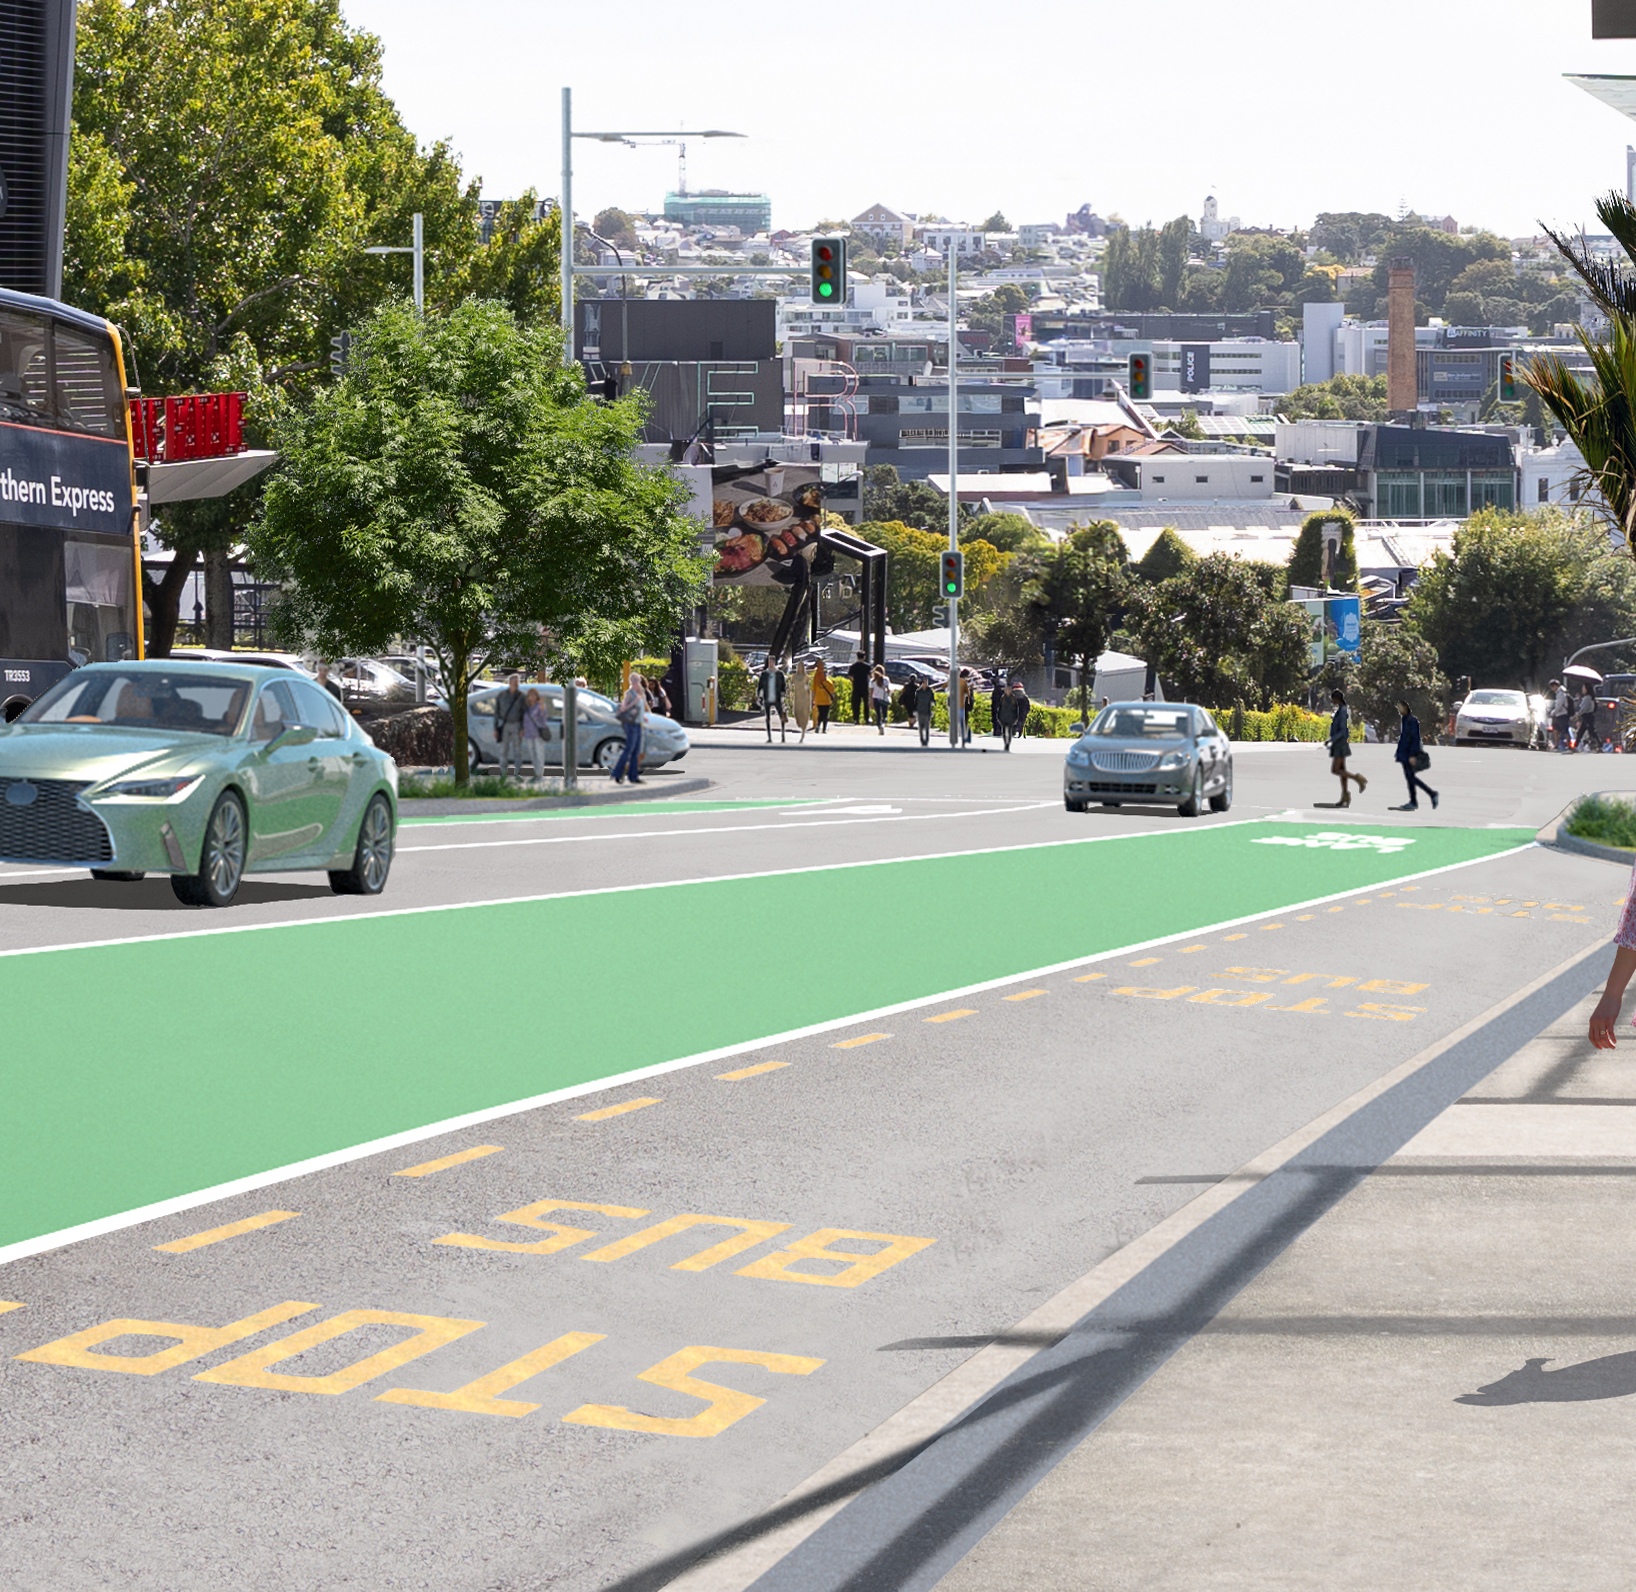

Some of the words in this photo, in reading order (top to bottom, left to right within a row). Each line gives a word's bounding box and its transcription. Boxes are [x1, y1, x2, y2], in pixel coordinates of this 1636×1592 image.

[1186, 351, 1195, 382] POLICE
[50, 475, 115, 517] Express
[4, 669, 31, 683] TR3553
[1208, 966, 1431, 995] BUS
[1107, 985, 1427, 1021] STOP
[431, 1199, 939, 1288] BUS
[10, 1299, 828, 1438] STOP
